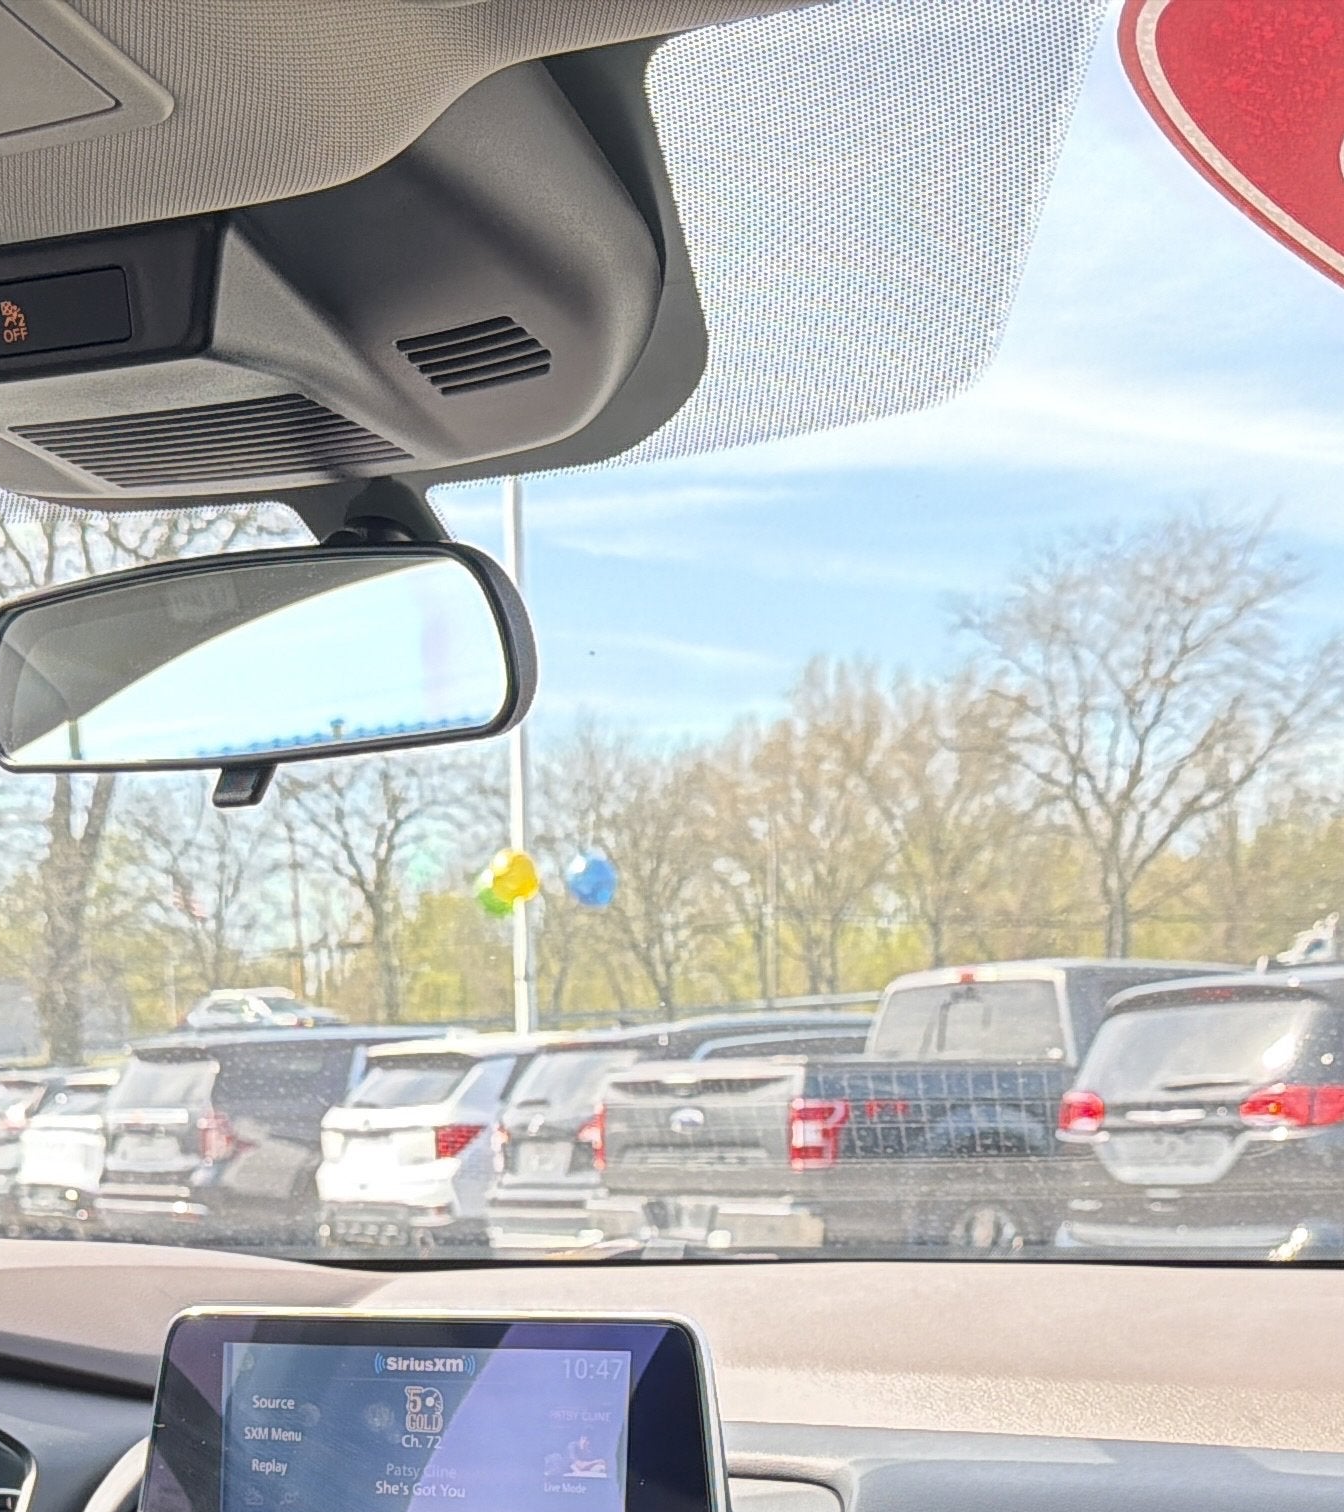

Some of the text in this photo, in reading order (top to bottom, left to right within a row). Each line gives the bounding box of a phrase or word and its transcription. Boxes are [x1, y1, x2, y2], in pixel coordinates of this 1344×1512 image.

[3, 327, 29, 343] OFF
[562, 1358, 624, 1380] 10:47
[252, 1394, 296, 1410] Source
[406, 1413, 443, 1432] GOLD
[244, 1426, 302, 1442] SXM Menu
[401, 1434, 443, 1450] Ch. 72
[251, 1458, 288, 1477] Replay
[386, 1463, 456, 1479] Patsy Cline
[375, 1481, 466, 1499] She's Got You
[562, 1482, 587, 1495] Mode
